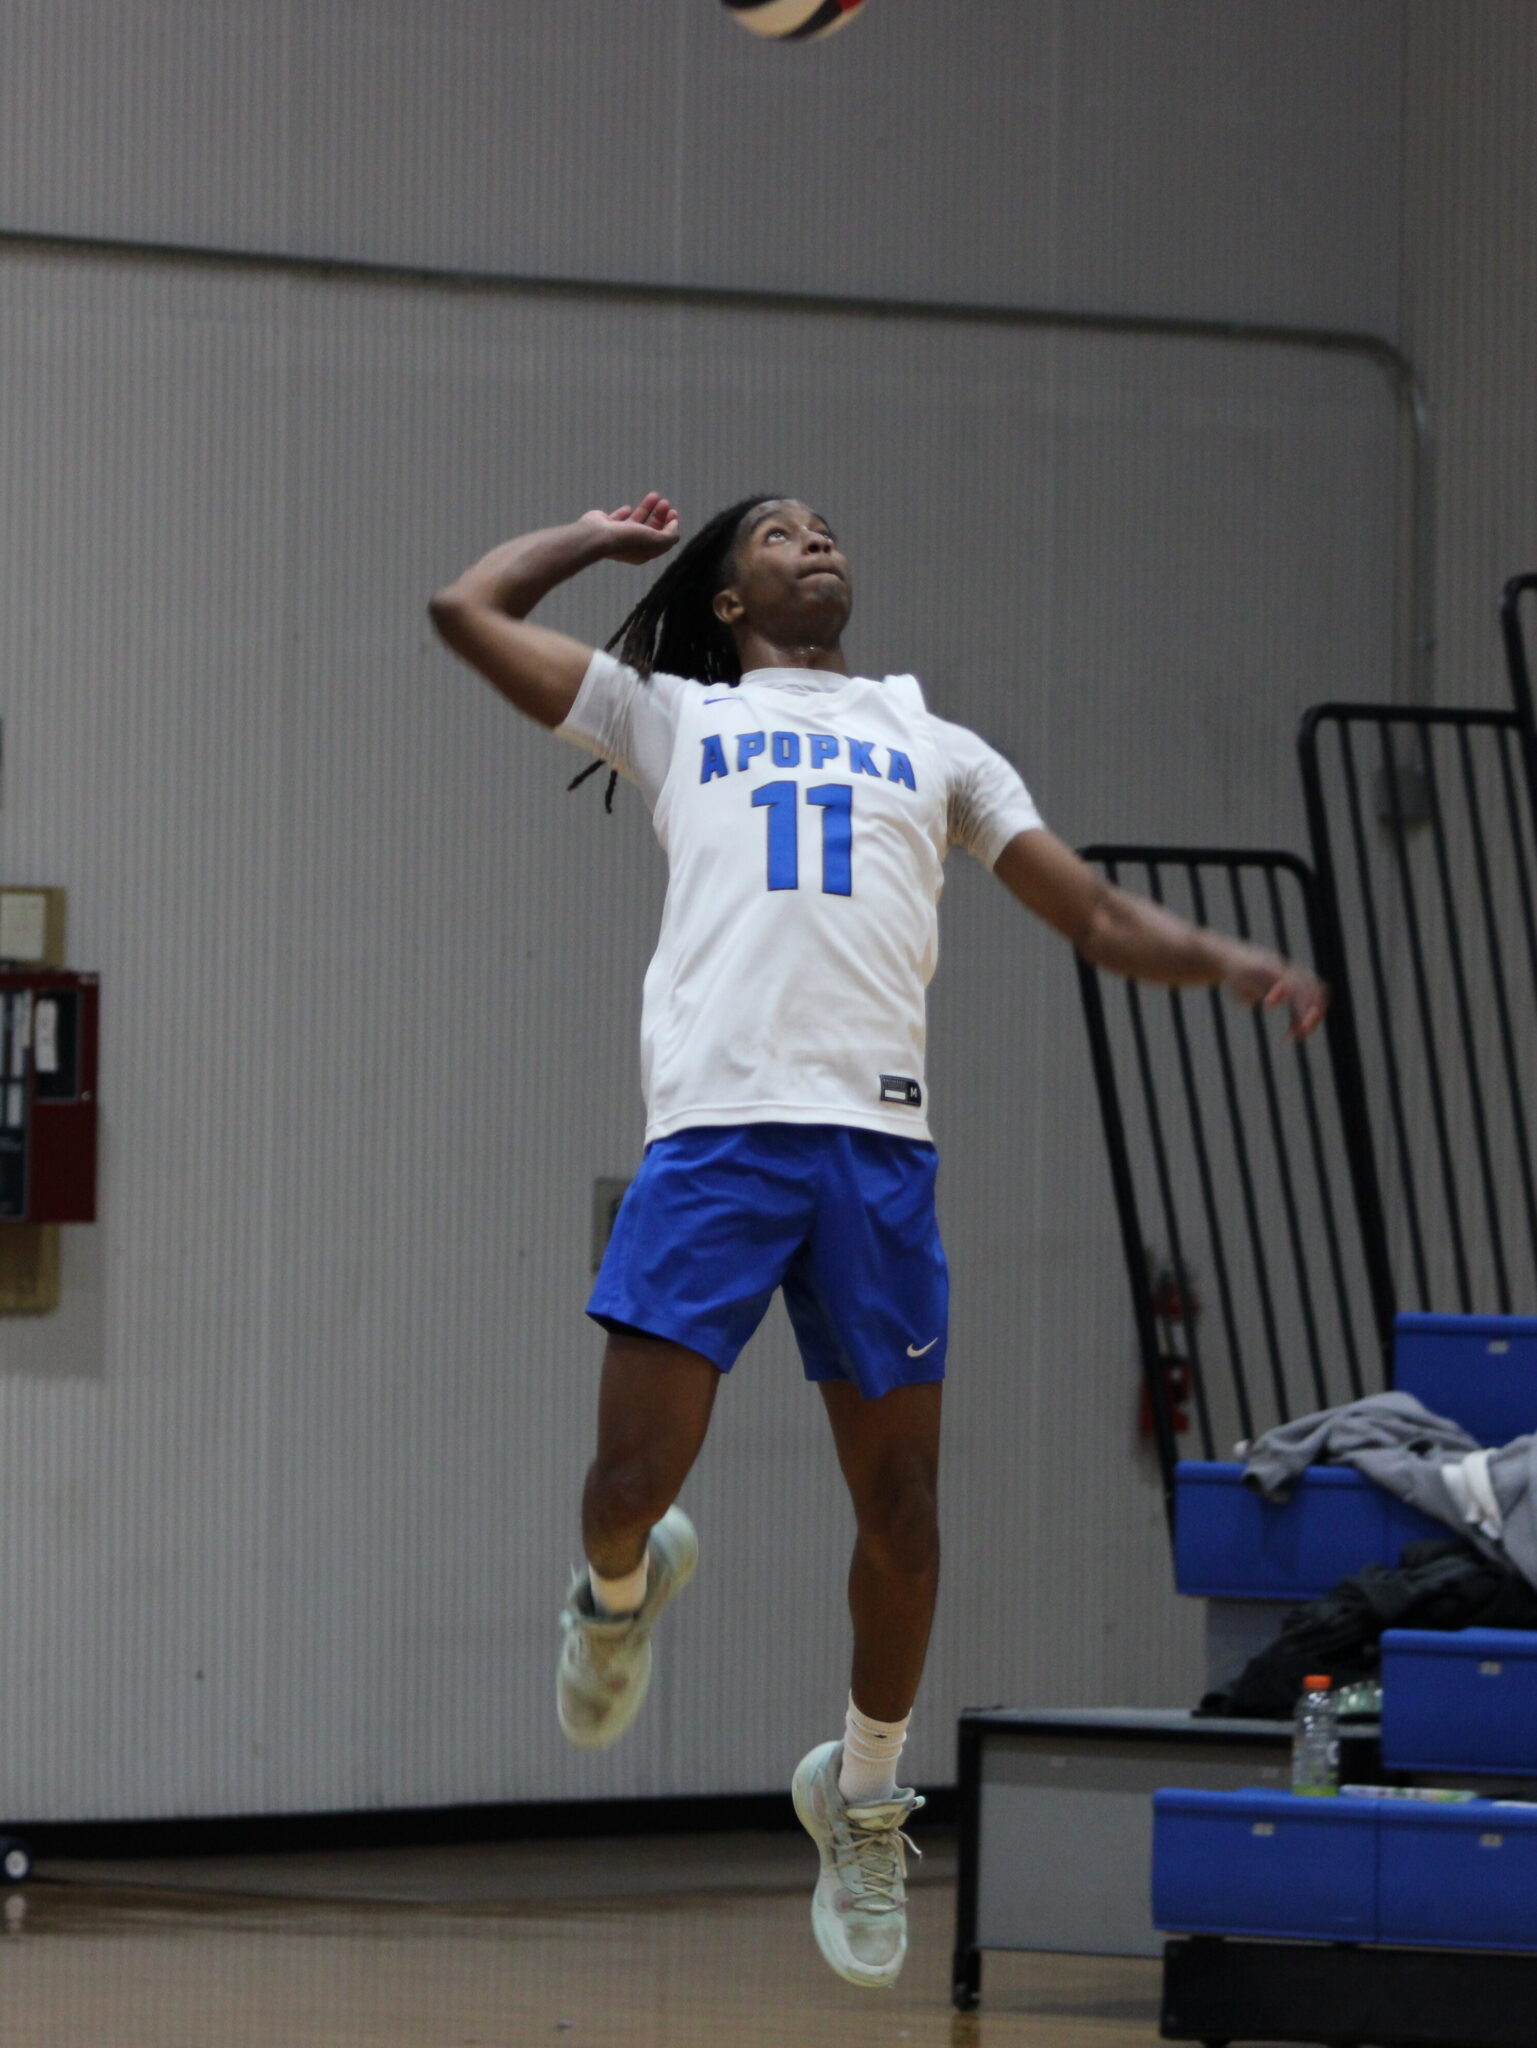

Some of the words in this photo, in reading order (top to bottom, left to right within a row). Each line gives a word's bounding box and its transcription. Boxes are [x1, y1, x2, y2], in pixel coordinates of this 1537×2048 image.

[700, 731, 917, 791] APOPKA
[751, 781, 853, 896] 11
[910, 1087, 918, 1098] M
